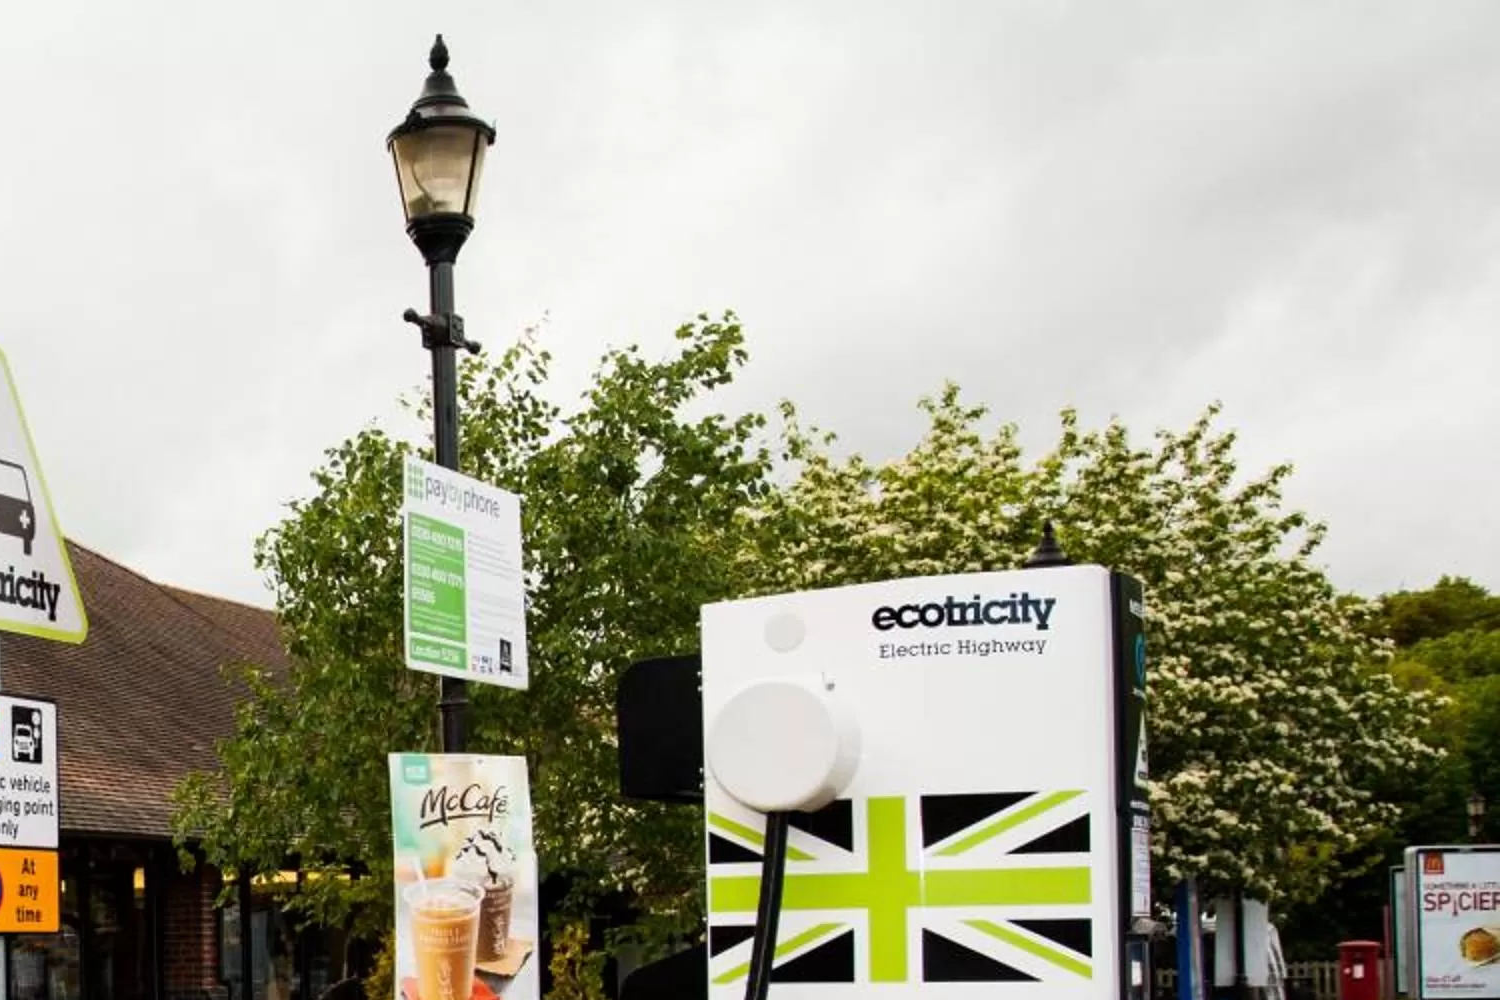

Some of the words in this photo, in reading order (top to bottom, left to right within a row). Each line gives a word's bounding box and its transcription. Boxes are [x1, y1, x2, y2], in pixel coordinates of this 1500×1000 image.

[872, 592, 1056, 631] ecotricity
[879, 640, 951, 659] Electric
[957, 639, 1047, 656] Highway
[9, 776, 51, 794] vehicle
[23, 801, 55, 818] point
[419, 783, 509, 828] McCafé
[21, 857, 36, 876] At
[18, 882, 39, 900] any
[16, 904, 42, 923] time
